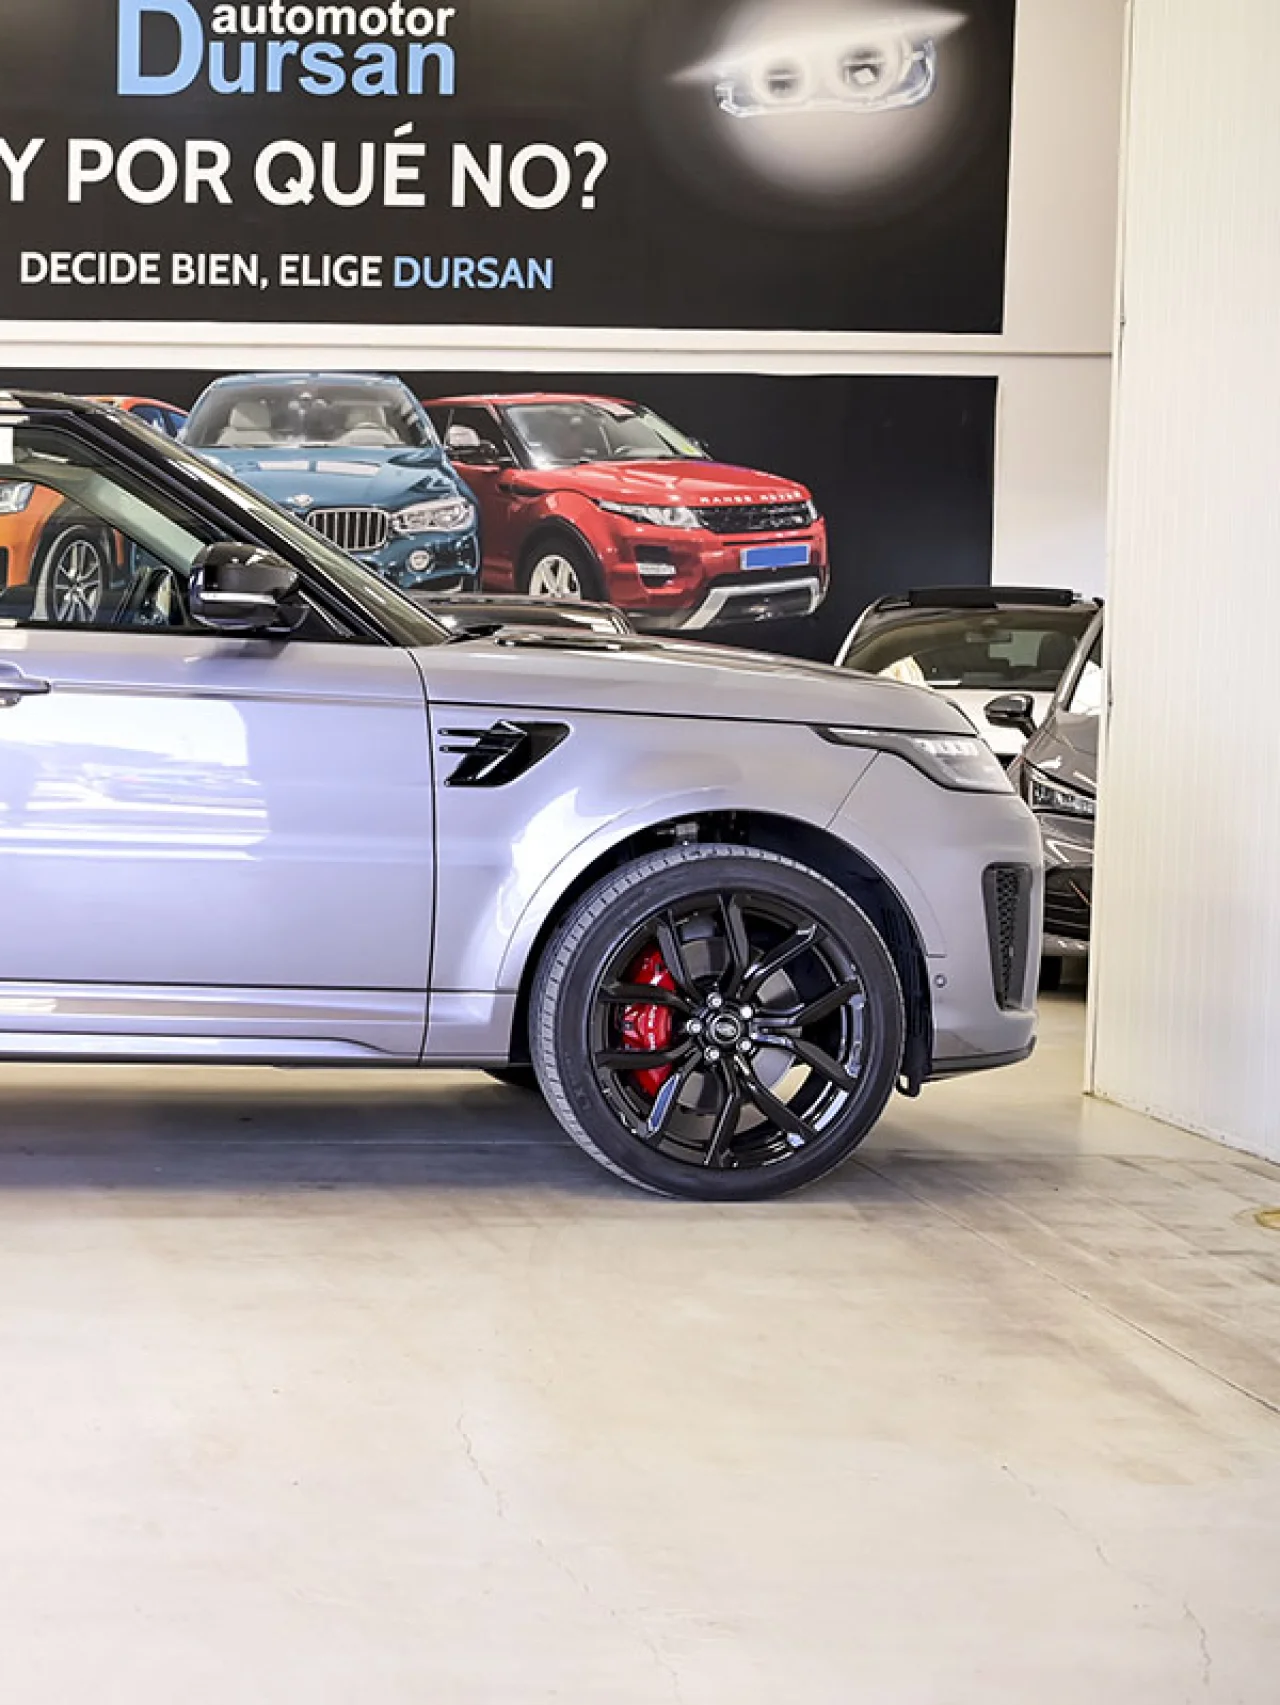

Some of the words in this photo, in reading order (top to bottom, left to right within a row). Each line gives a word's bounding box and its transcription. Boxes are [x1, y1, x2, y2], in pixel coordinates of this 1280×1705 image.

[117, 0, 456, 96] Dursan
[210, 0, 456, 36] automotor
[67, 138, 233, 205] POR
[253, 121, 427, 207] QUÉ
[450, 140, 608, 210] NO?
[20, 251, 161, 286] DECIDE
[171, 253, 270, 290] BIEN,
[279, 254, 383, 288] ELIGE
[392, 256, 554, 290] DURSAN
